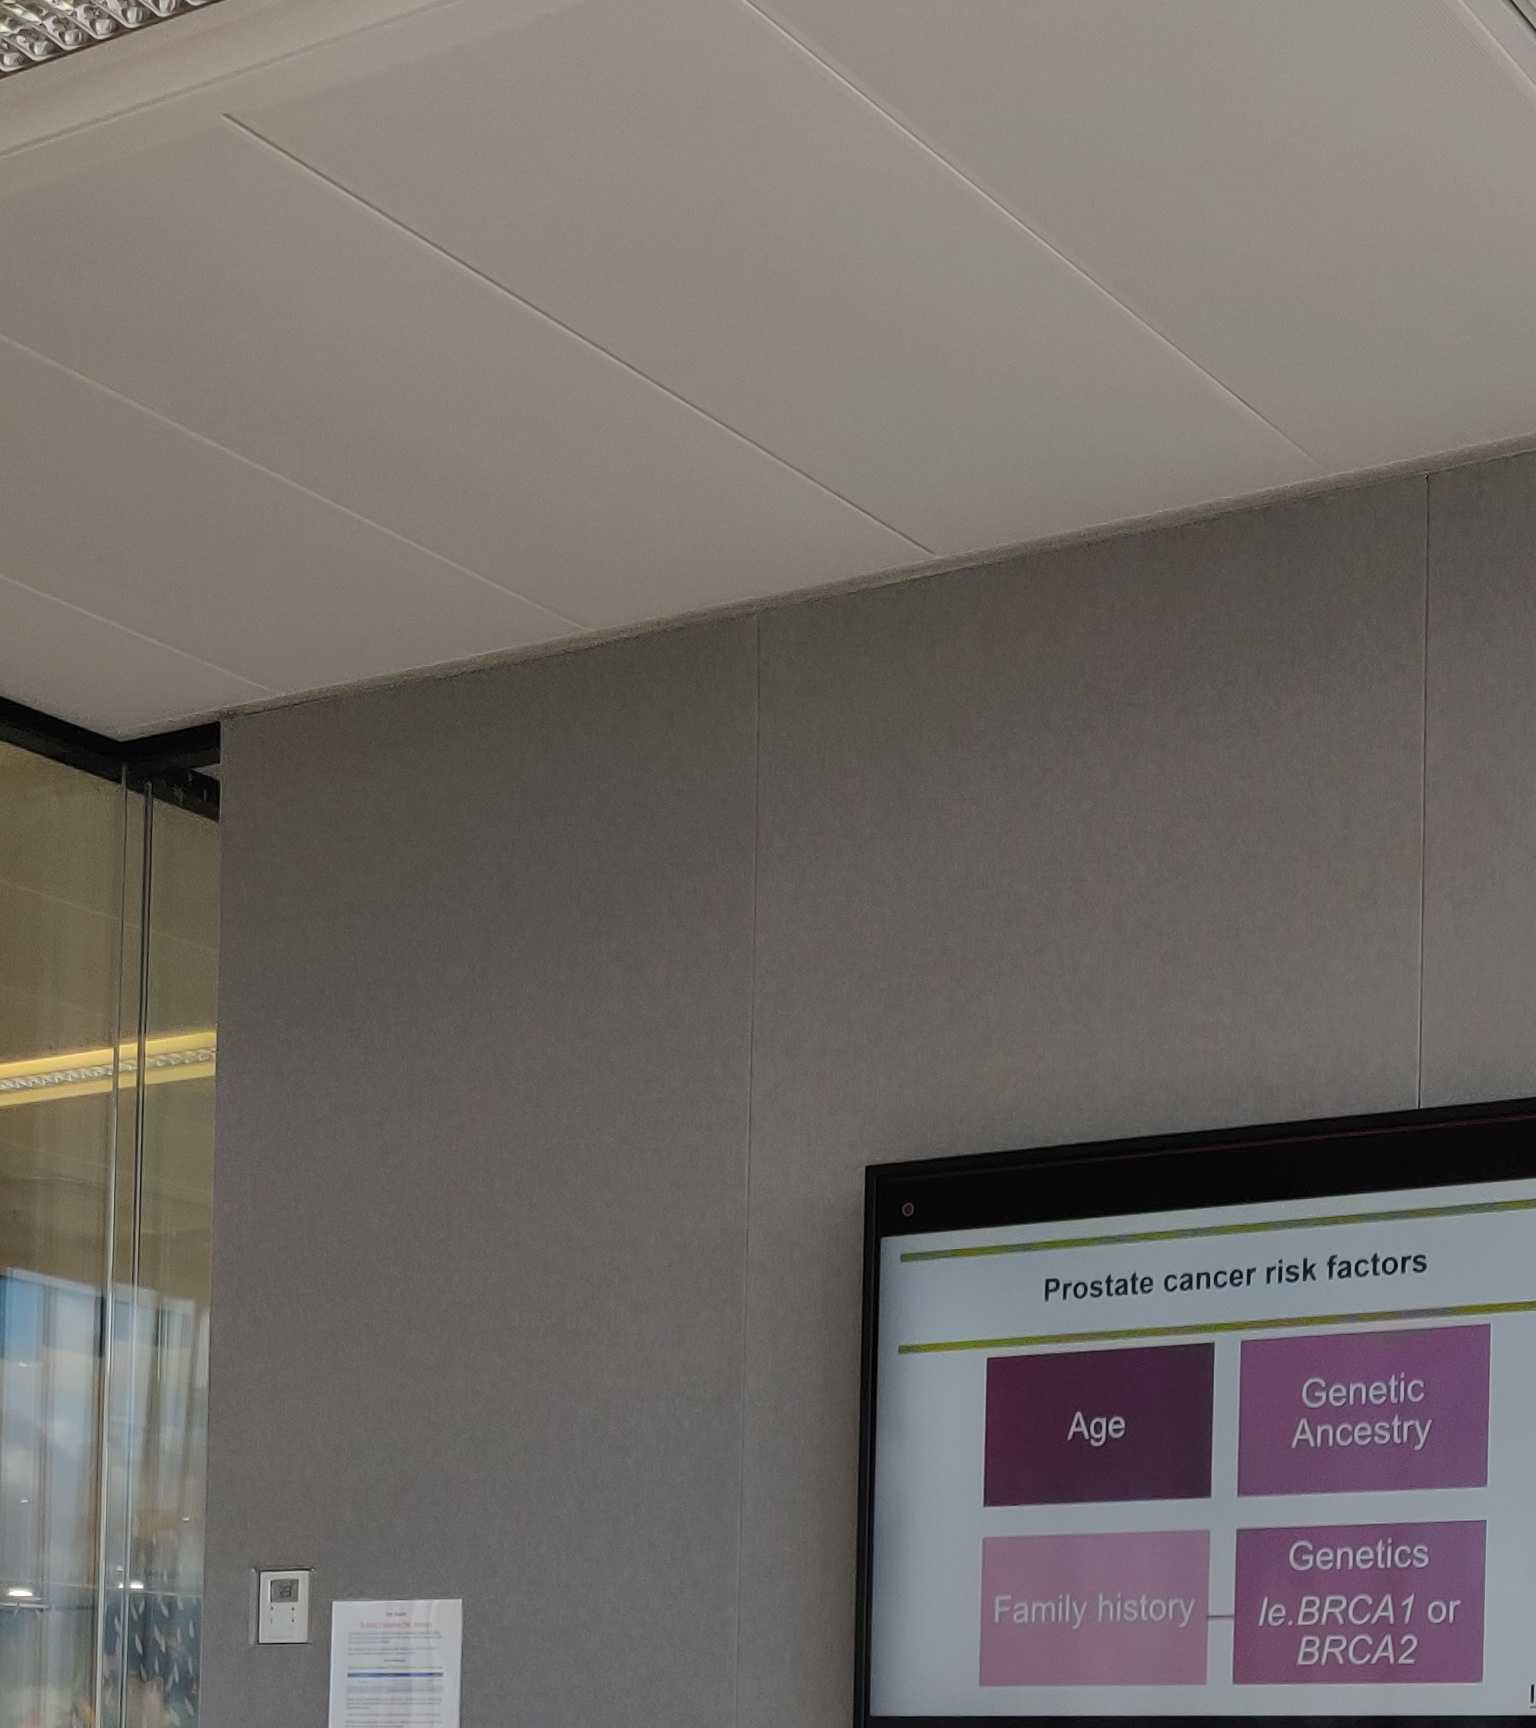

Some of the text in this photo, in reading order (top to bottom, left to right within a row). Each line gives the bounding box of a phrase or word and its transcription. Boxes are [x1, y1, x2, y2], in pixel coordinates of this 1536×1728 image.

[1043, 1252, 1429, 1302] Prostate cancer risk factors
[1301, 1372, 1425, 1409] Genetic
[1066, 1411, 1127, 1447] Age
[1291, 1415, 1433, 1452] Ancestry
[1288, 1538, 1430, 1573] Genetics
[992, 1591, 1197, 1631] Family history
[1426, 1598, 1461, 1625] or
[1296, 1634, 1419, 1667] BRCA2
